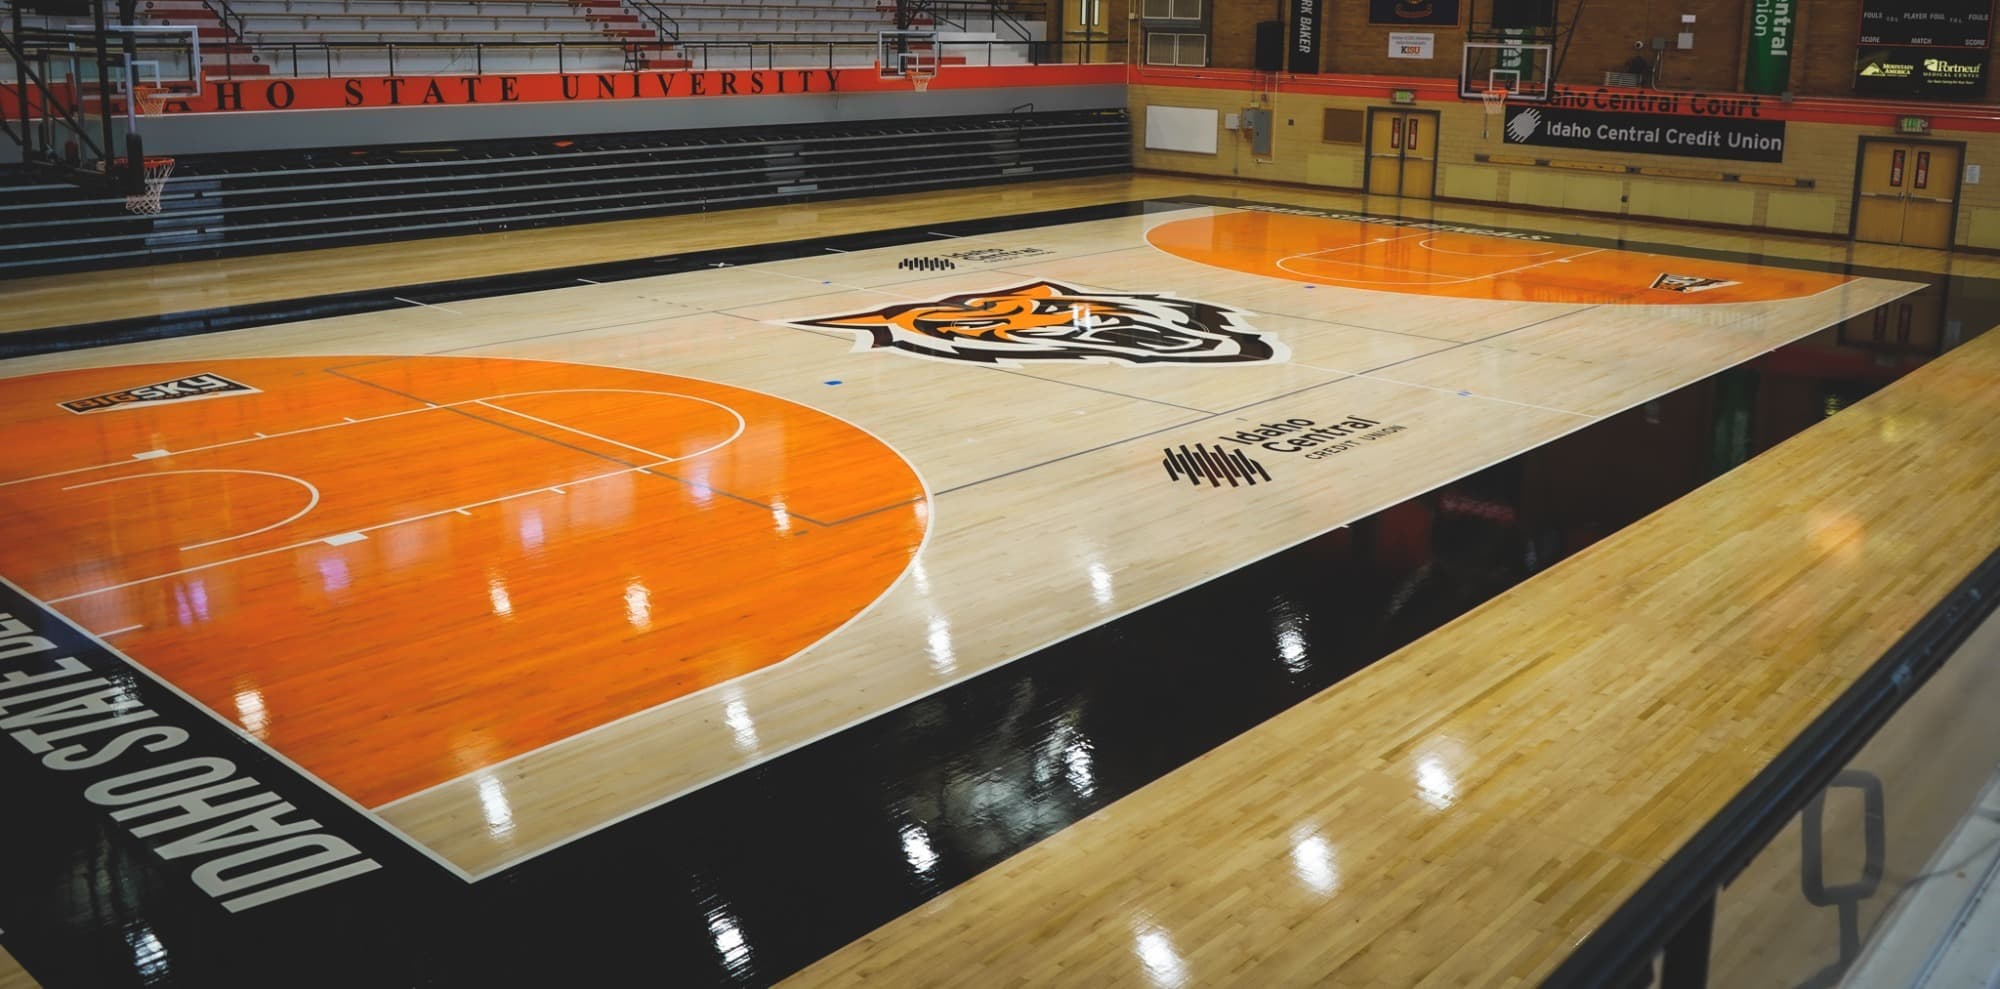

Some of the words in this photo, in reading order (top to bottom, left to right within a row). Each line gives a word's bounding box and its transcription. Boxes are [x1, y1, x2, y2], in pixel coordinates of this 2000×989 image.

[1298, 17, 1312, 53] BAKER
[1938, 60, 1982, 73] Portneuf
[344, 77, 519, 106] STATE
[562, 71, 841, 99] UNIVERSITY
[1594, 89, 1678, 113] Central
[1691, 94, 1760, 117] Court
[1547, 121, 1591, 138] Idaho
[1596, 125, 1660, 144] Central
[1665, 128, 1720, 147] Credit
[1728, 132, 1782, 151] Union
[1219, 418, 1315, 445] Idaho
[1262, 415, 1381, 453] Central
[1305, 440, 1360, 460] CREDIT
[1359, 425, 1407, 442] UNION
[84, 756, 383, 914] IDAHO
